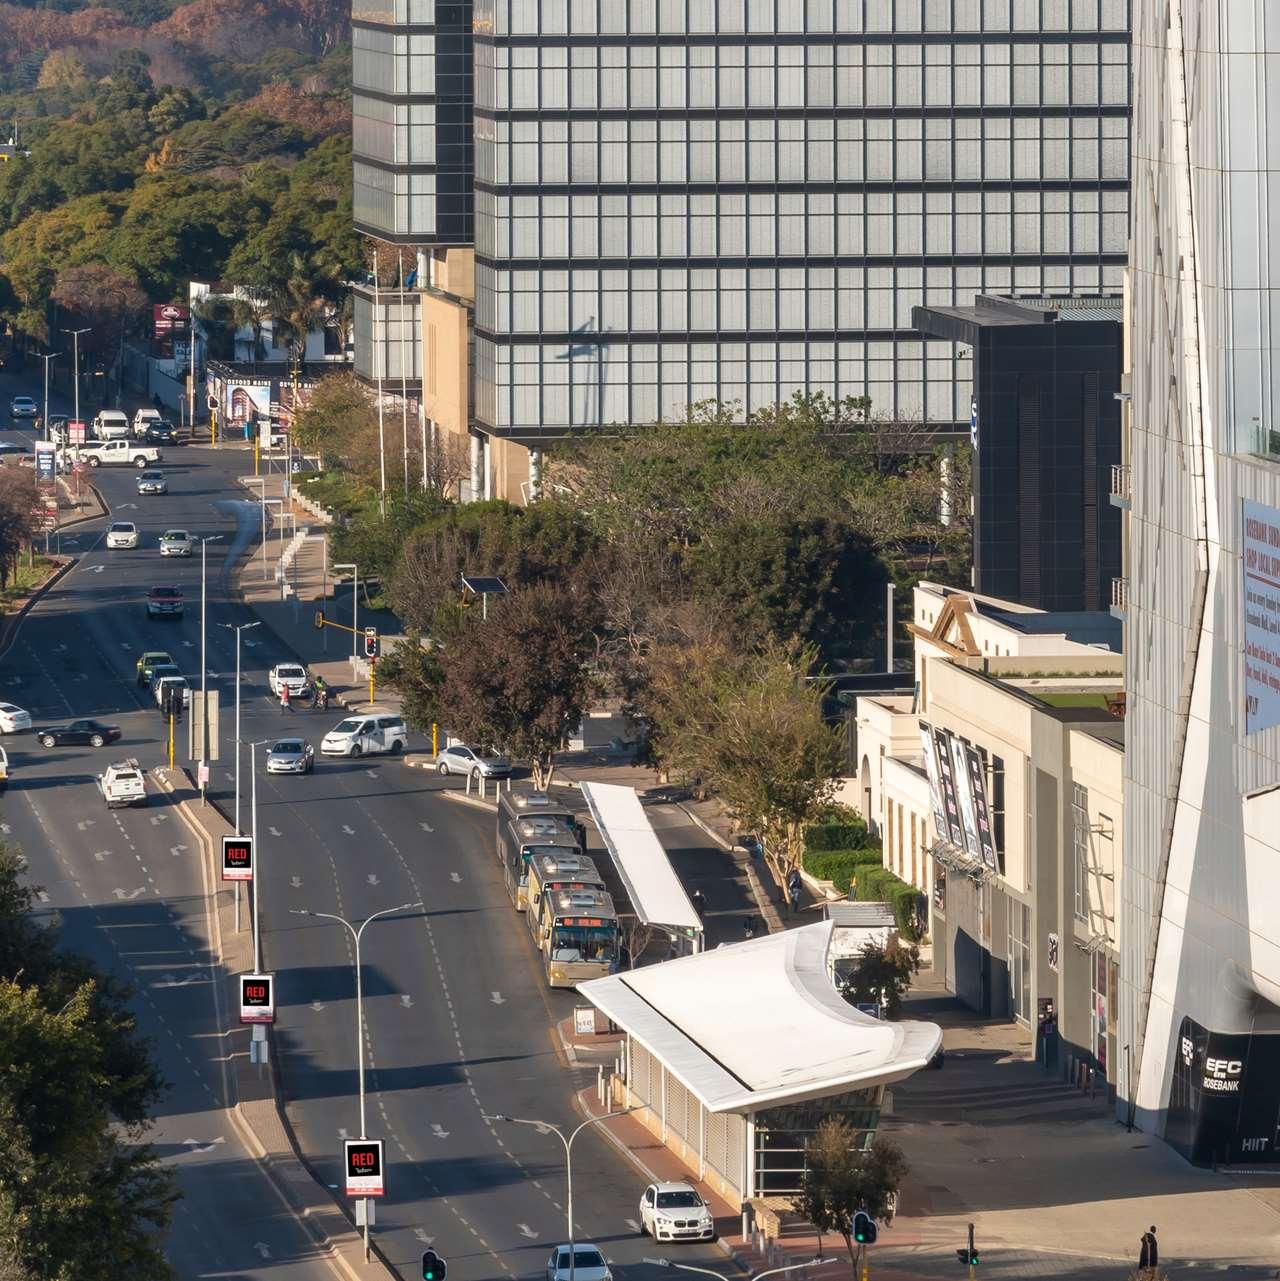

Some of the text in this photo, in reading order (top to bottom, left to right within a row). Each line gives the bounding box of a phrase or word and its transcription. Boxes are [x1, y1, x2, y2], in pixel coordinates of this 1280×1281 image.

[228, 848, 247, 860] RED
[246, 986, 265, 998] RED
[1205, 1057, 1243, 1074] EFC
[1203, 1077, 1240, 1092] ROSEBANK
[1242, 1137, 1269, 1152] HIIT
[351, 1152, 375, 1166] RED
